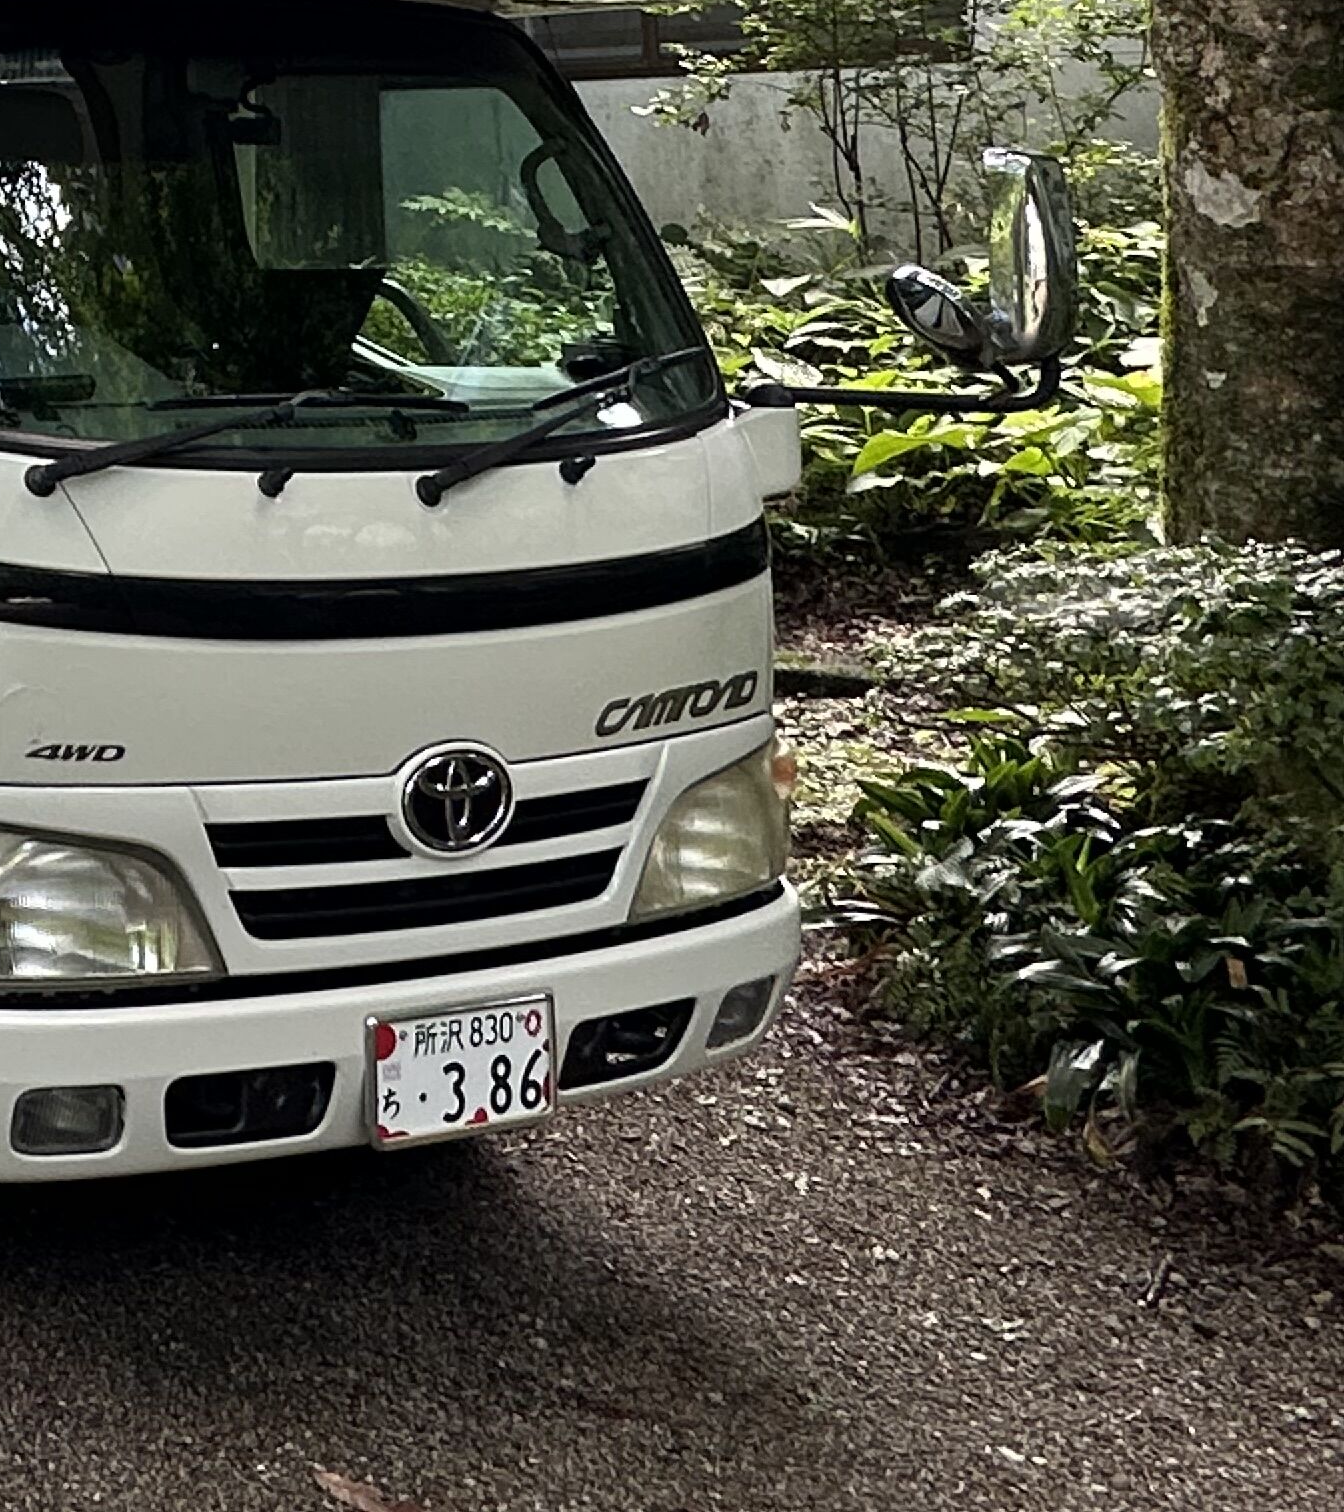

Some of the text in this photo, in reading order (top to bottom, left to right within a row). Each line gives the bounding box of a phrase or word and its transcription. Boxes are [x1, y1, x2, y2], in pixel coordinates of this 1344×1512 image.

[25, 744, 126, 762] 4WD
[415, 1012, 514, 1057] 所沢 830
[382, 1088, 400, 1120] ち
